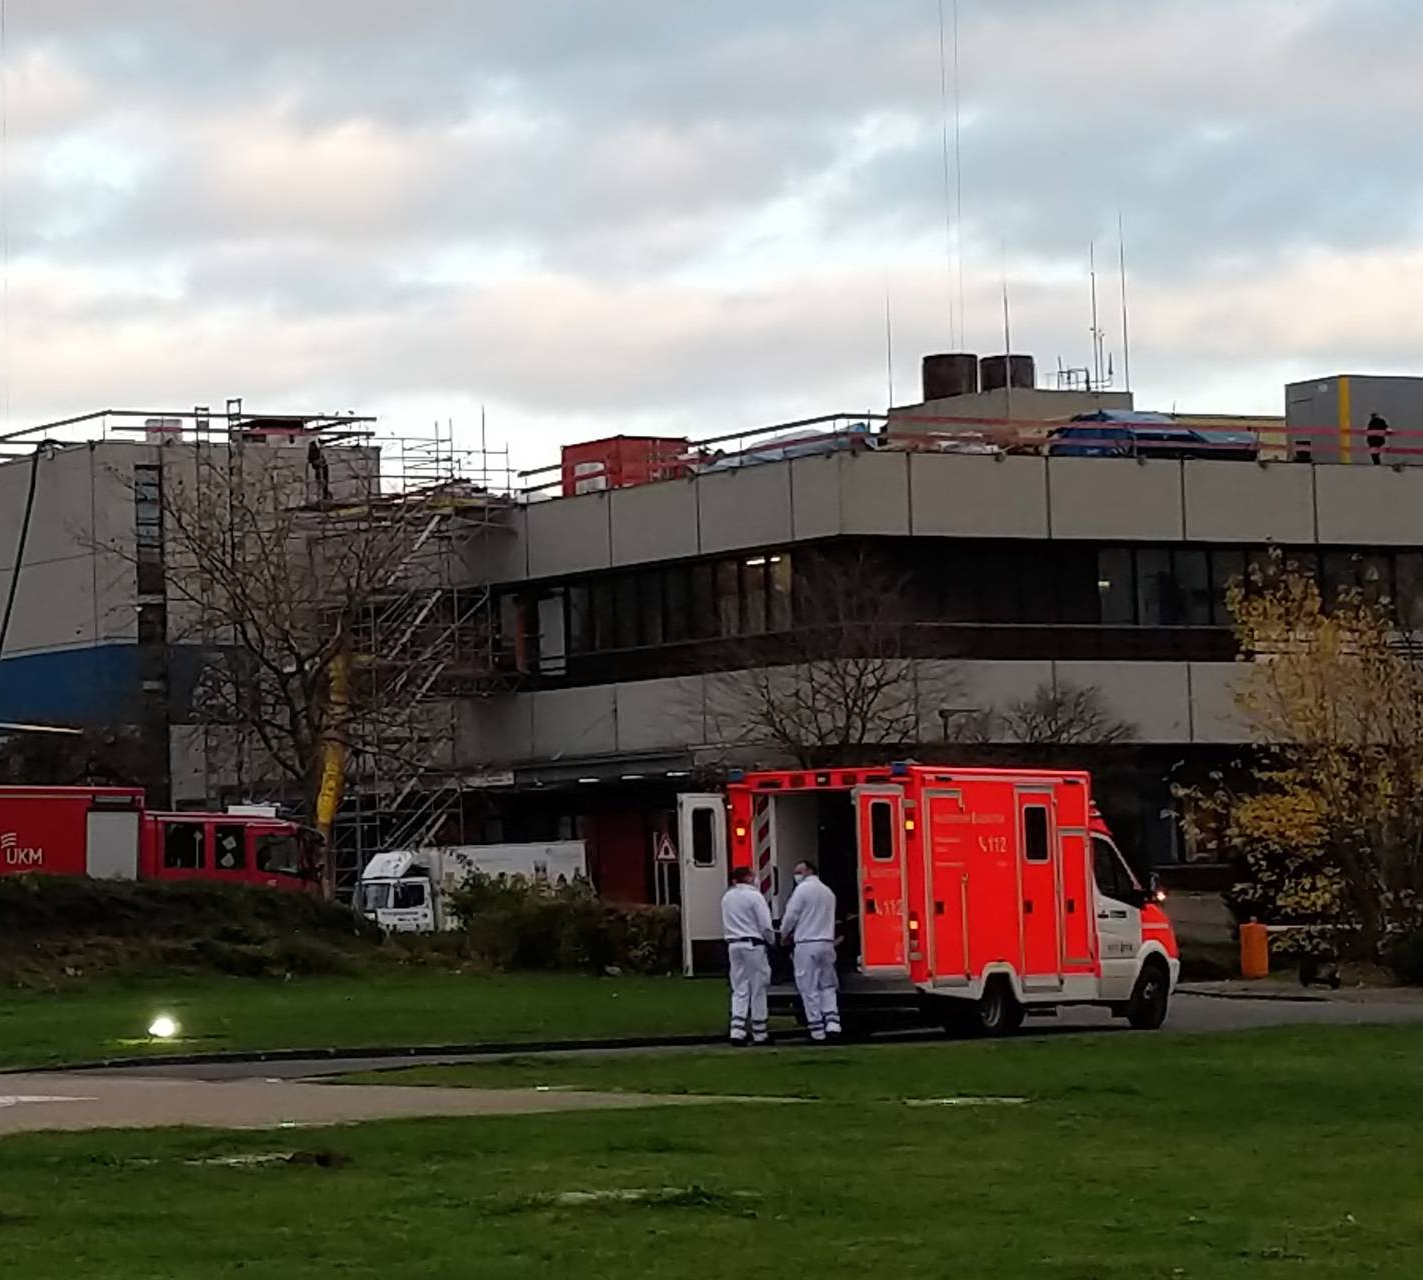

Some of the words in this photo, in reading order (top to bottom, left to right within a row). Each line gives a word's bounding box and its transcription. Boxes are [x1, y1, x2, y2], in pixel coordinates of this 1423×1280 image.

[988, 837, 1007, 853] 112
[6, 847, 43, 865] UKM
[883, 899, 903, 916] 112
